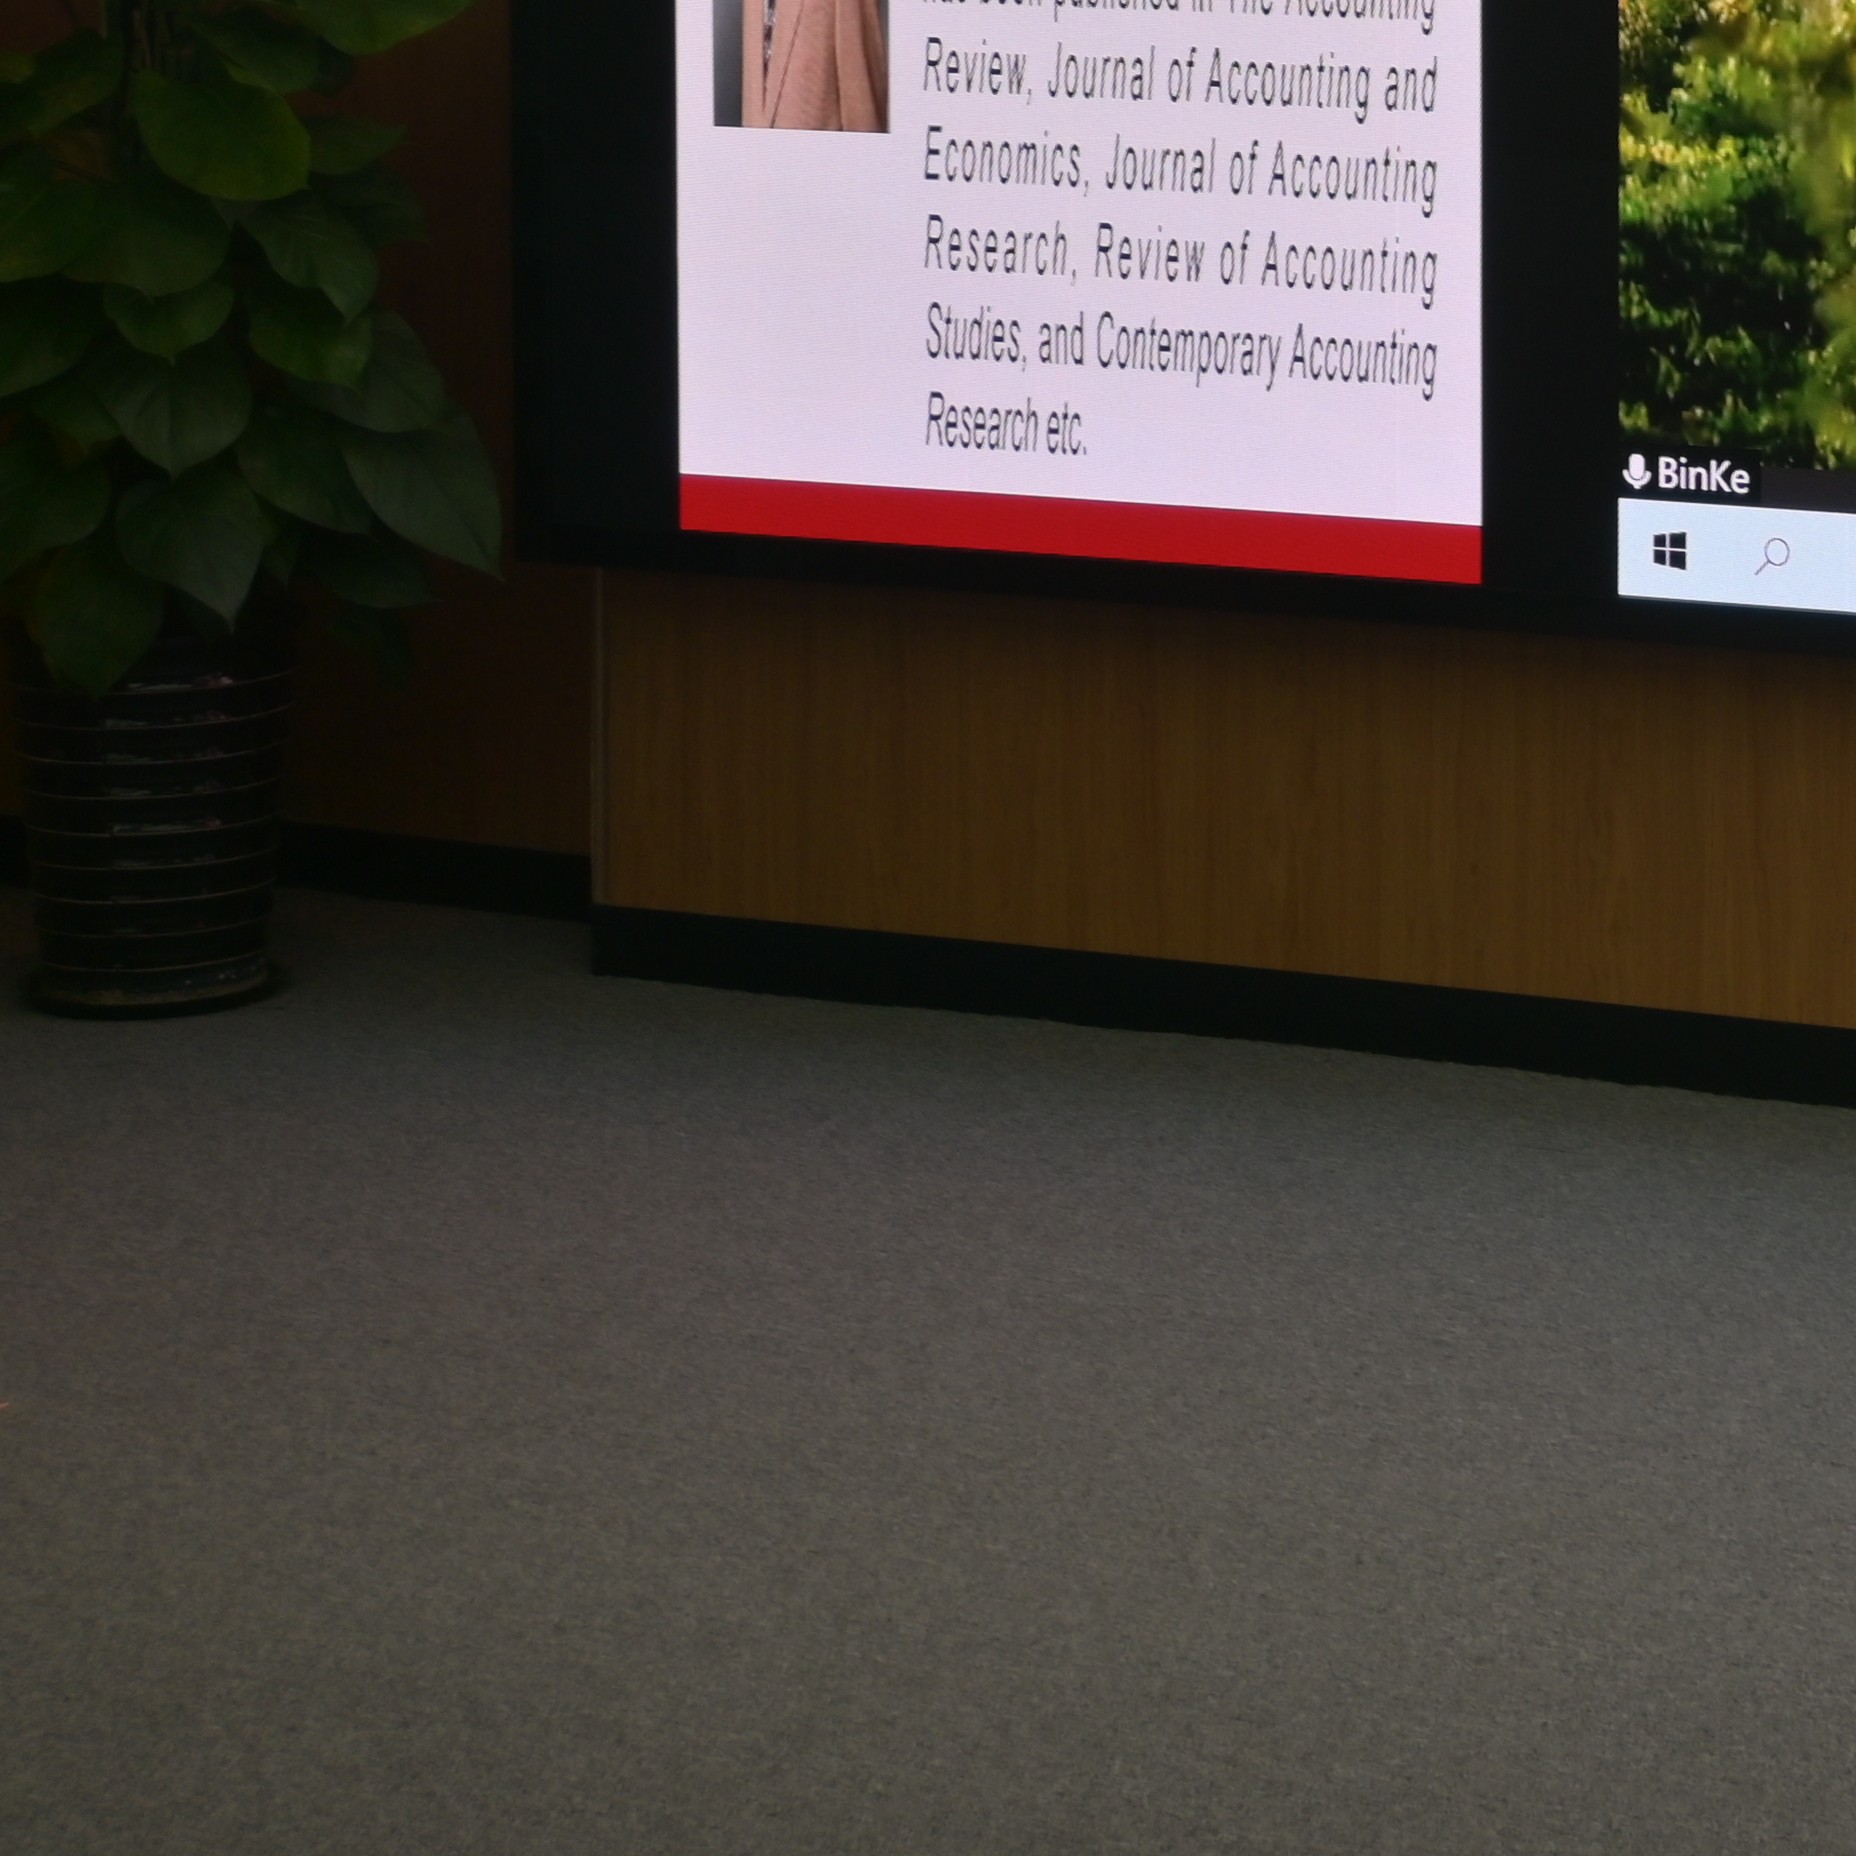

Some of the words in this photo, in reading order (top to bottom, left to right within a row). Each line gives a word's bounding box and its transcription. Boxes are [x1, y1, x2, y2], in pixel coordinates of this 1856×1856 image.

[923, 36, 1033, 105] Review,
[1048, 41, 1155, 102] Journal
[1168, 46, 1197, 102] of
[1205, 47, 1370, 124] Accounting
[1384, 56, 1437, 113] and
[924, 125, 1090, 197] Economics,
[1106, 132, 1215, 194] Journal
[1230, 139, 1258, 195] of
[1268, 140, 1437, 218] Accounting
[924, 213, 1076, 286] Research,
[1095, 222, 1204, 282] Review
[1219, 228, 1250, 285] of
[1261, 230, 1438, 310] Accounting
[926, 301, 1028, 372] Studies,
[1038, 311, 1084, 366] and
[1097, 311, 1282, 391] Contemporary
[1289, 323, 1438, 401] Accounting
[926, 390, 1038, 452] Research
[1047, 401, 1087, 456] etc.
[1658, 456, 1750, 495] BinKe
